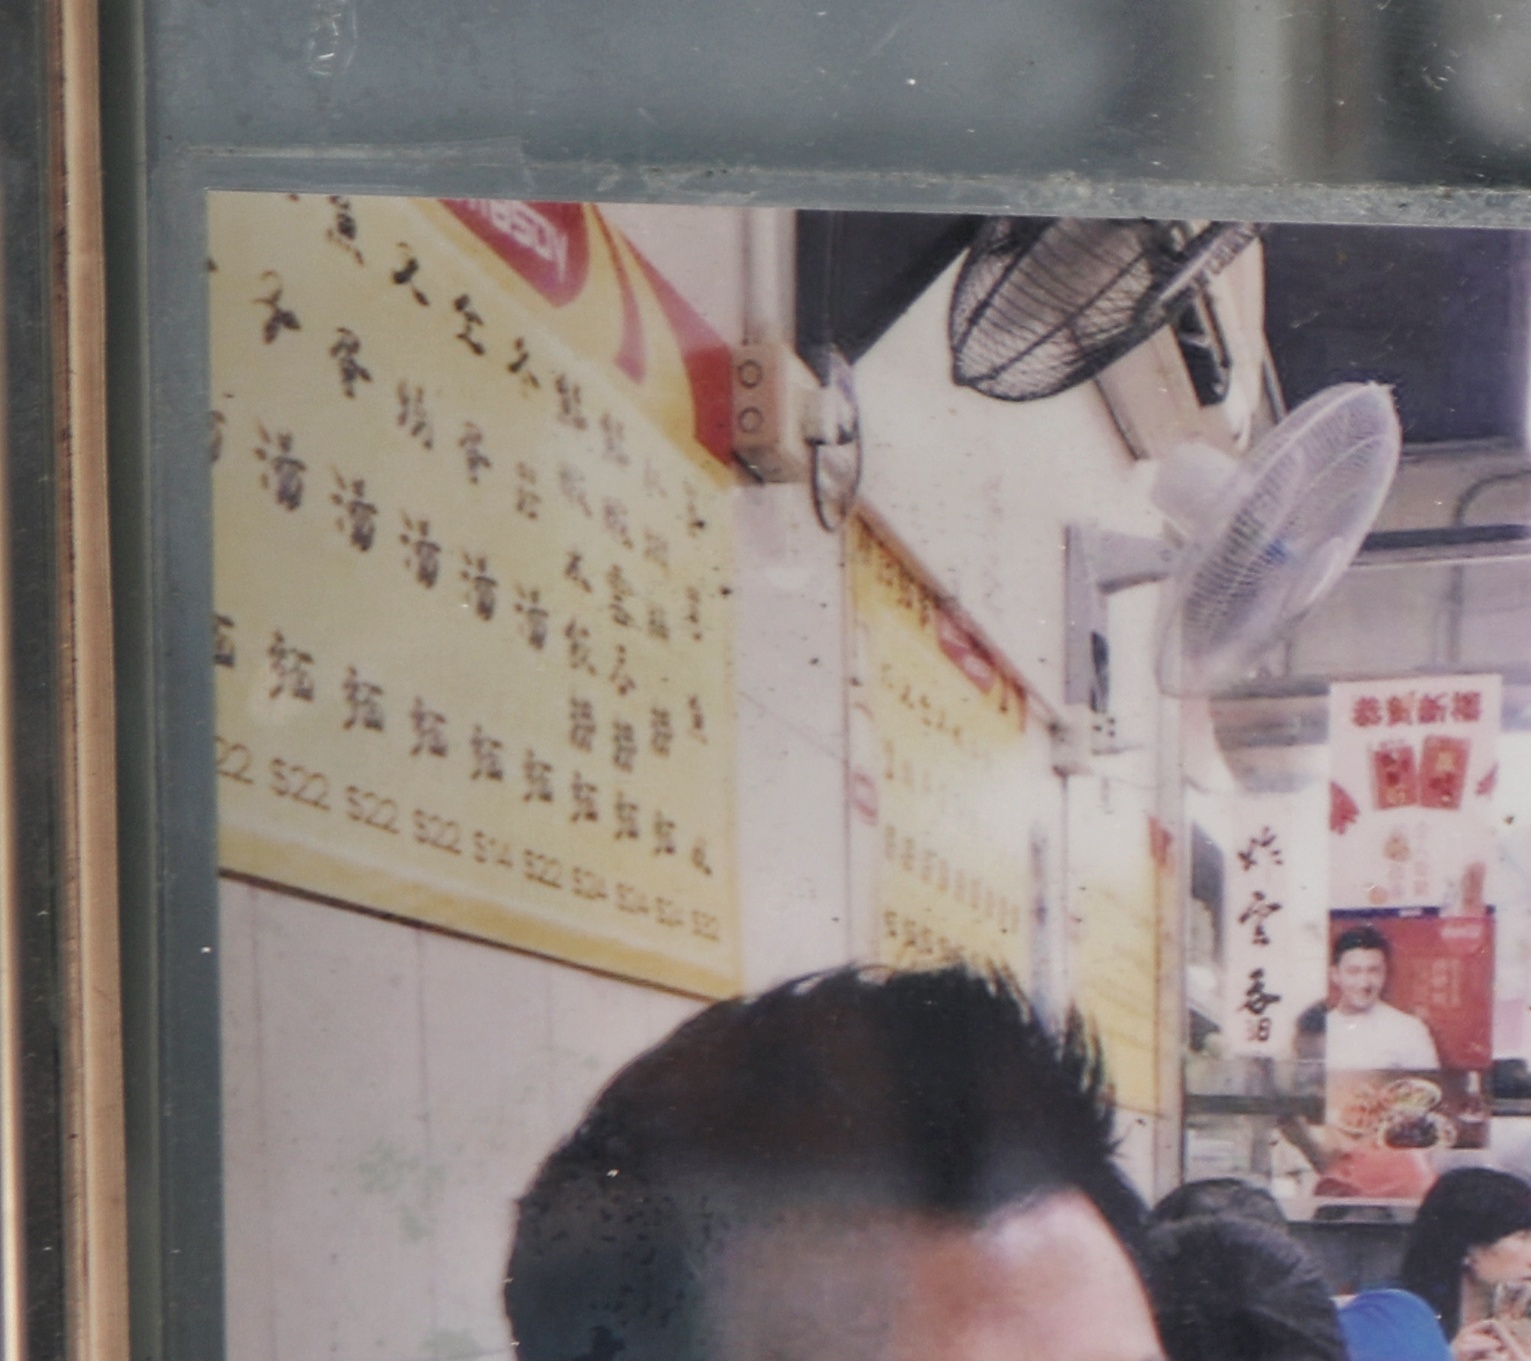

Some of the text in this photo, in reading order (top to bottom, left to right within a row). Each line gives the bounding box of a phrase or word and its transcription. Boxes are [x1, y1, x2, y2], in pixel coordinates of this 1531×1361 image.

[271, 757, 331, 811] $22
[346, 785, 400, 835] $22
[412, 808, 462, 855] $22
